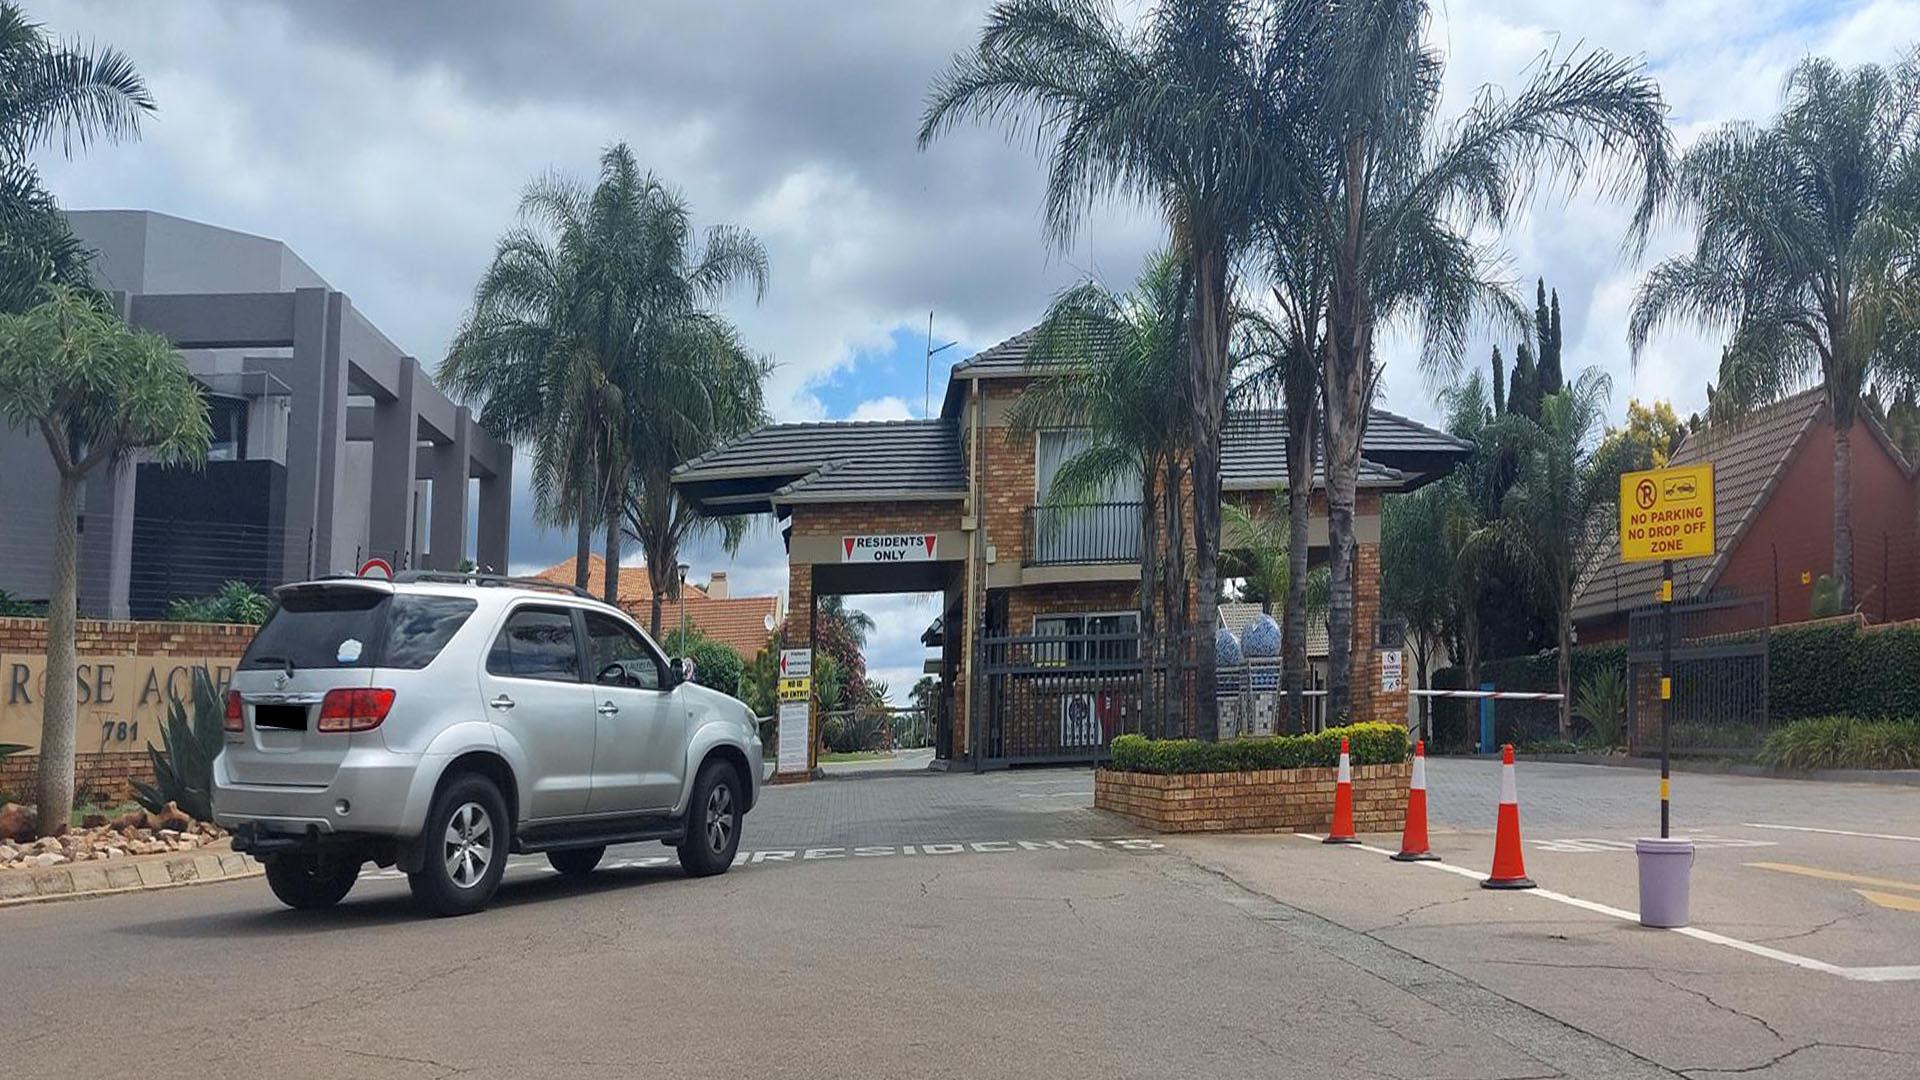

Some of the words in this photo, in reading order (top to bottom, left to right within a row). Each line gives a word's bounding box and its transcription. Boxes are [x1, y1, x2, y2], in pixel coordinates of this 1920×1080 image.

[1631, 514, 1647, 525] NO
[1651, 507, 1704, 523] PARKING
[1628, 528, 1645, 540] NO
[1649, 524, 1680, 538] DROP
[1683, 521, 1706, 535] OFF
[856, 535, 924, 548] RESIDENTS
[1651, 539, 1684, 553] ZONE
[874, 550, 906, 561] ONLY
[9, 663, 115, 704] RSE
[787, 680, 796, 688] NO
[796, 680, 803, 688] ID
[780, 691, 789, 699] NO
[102, 721, 138, 742] 781
[751, 838, 1165, 863] RESIDENTS
